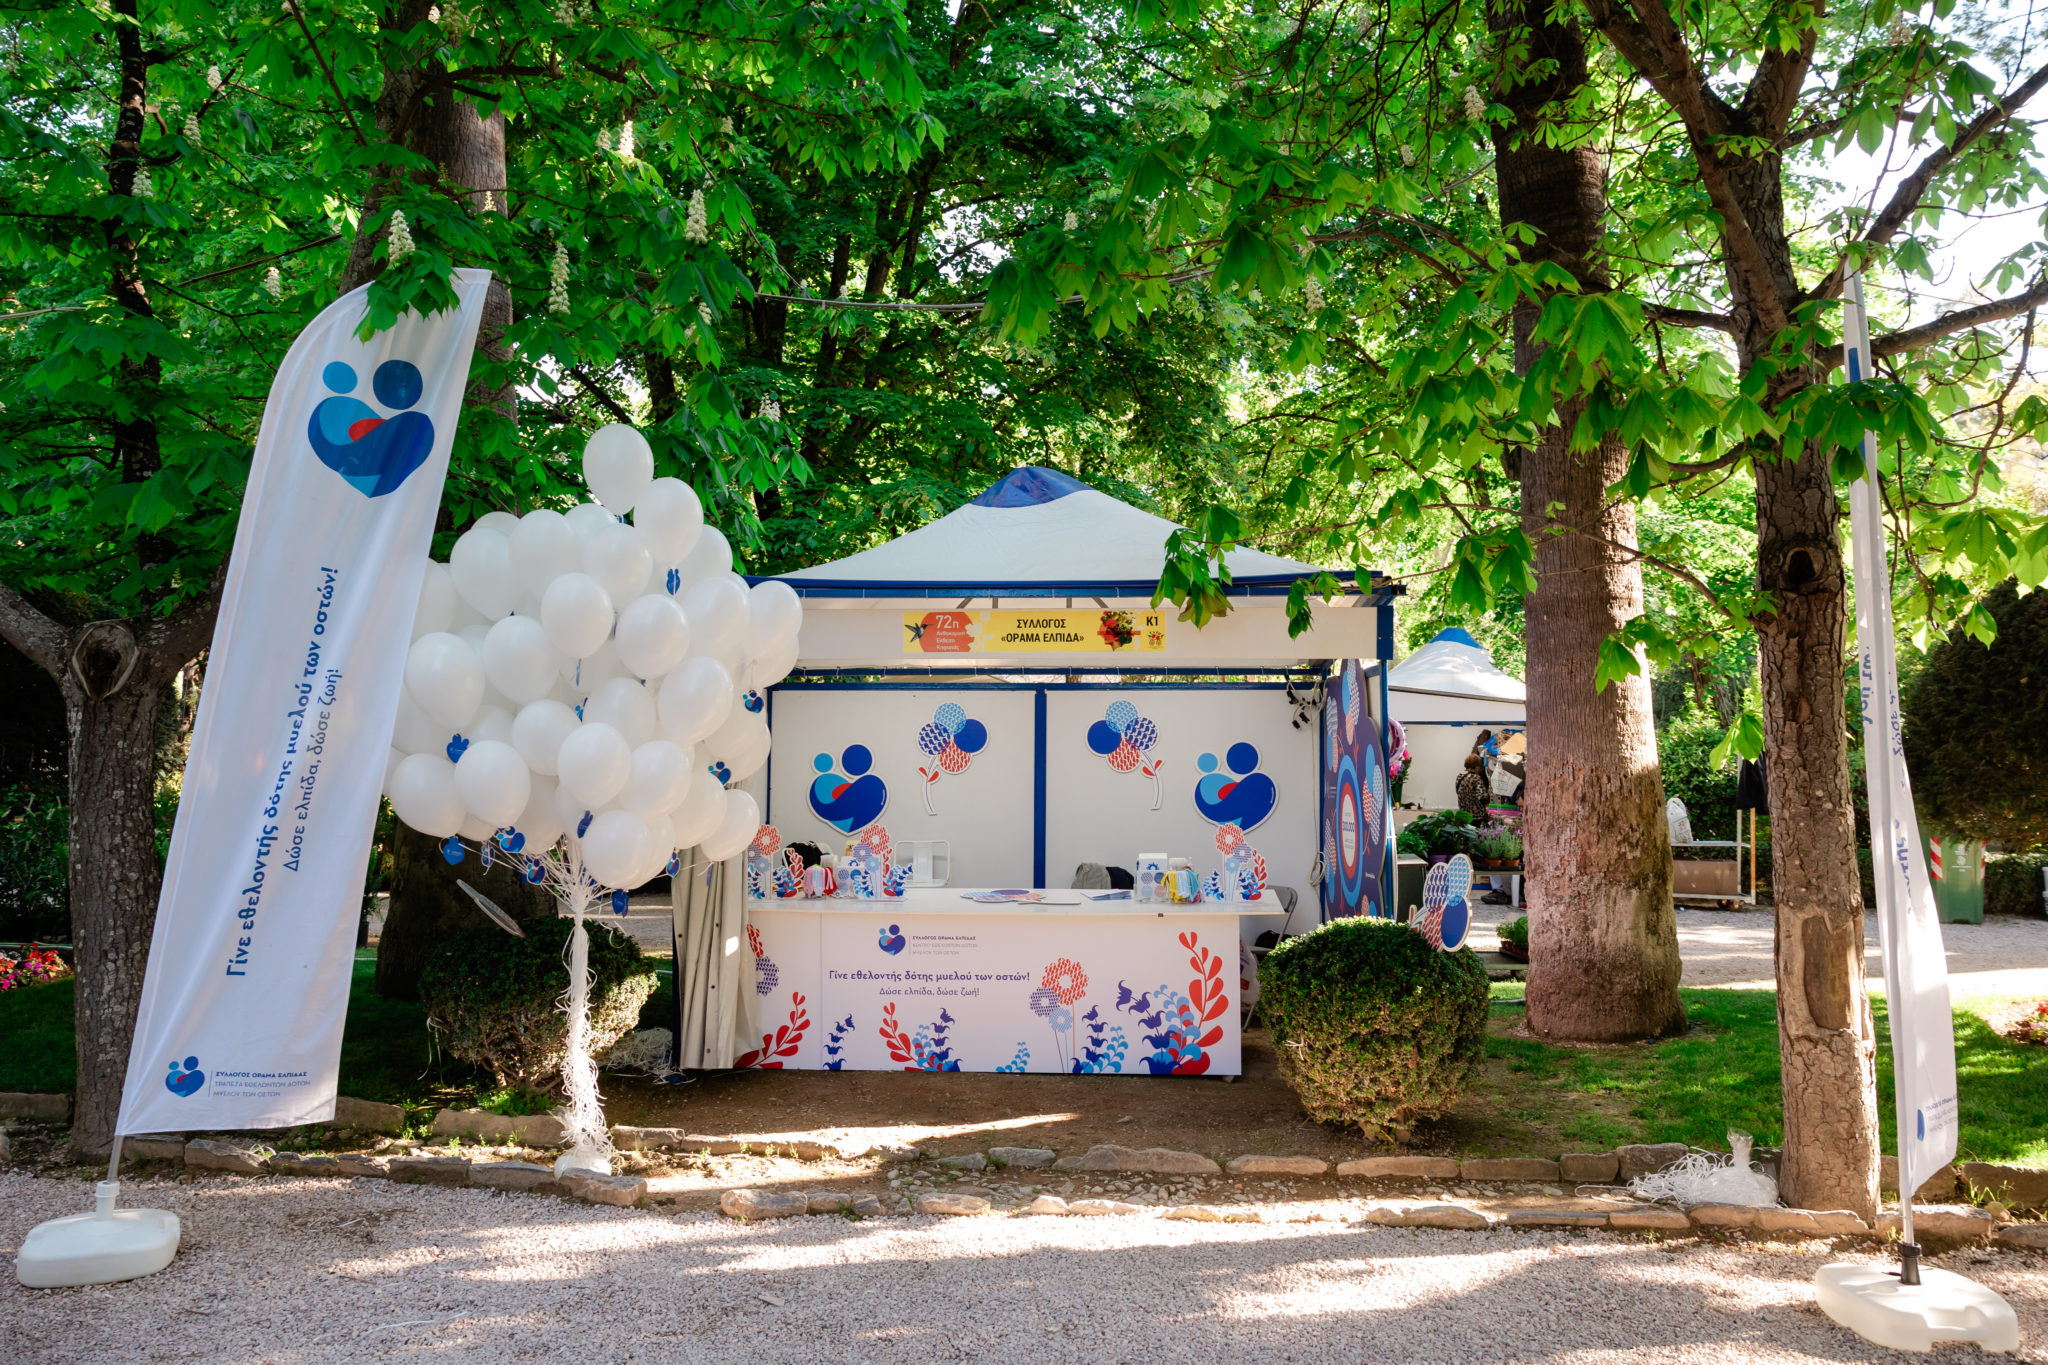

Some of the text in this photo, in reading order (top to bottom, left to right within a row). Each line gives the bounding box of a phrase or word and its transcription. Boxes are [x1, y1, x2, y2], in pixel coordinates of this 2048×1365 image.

[1016, 618, 1066, 629] ΣΥΛΛΟΓΟΣ
[1001, 632, 1084, 643] «ΟΡΑΜΑ ΕΛΠΙΔΑ»
[226, 567, 338, 976] Γίνε εθελοντής δότης μυελού των οστών!
[283, 669, 342, 872] Δώσε ελπίδα, δώσε ζωή!
[829, 970, 848, 980] Γίνε
[850, 970, 902, 981] εθελοντής
[904, 970, 933, 982] δότης
[936, 971, 972, 982] μυελού
[995, 971, 1030, 981] οστών!
[879, 987, 980, 997] Δώσε ελπίδα, δώσε ζωή!
